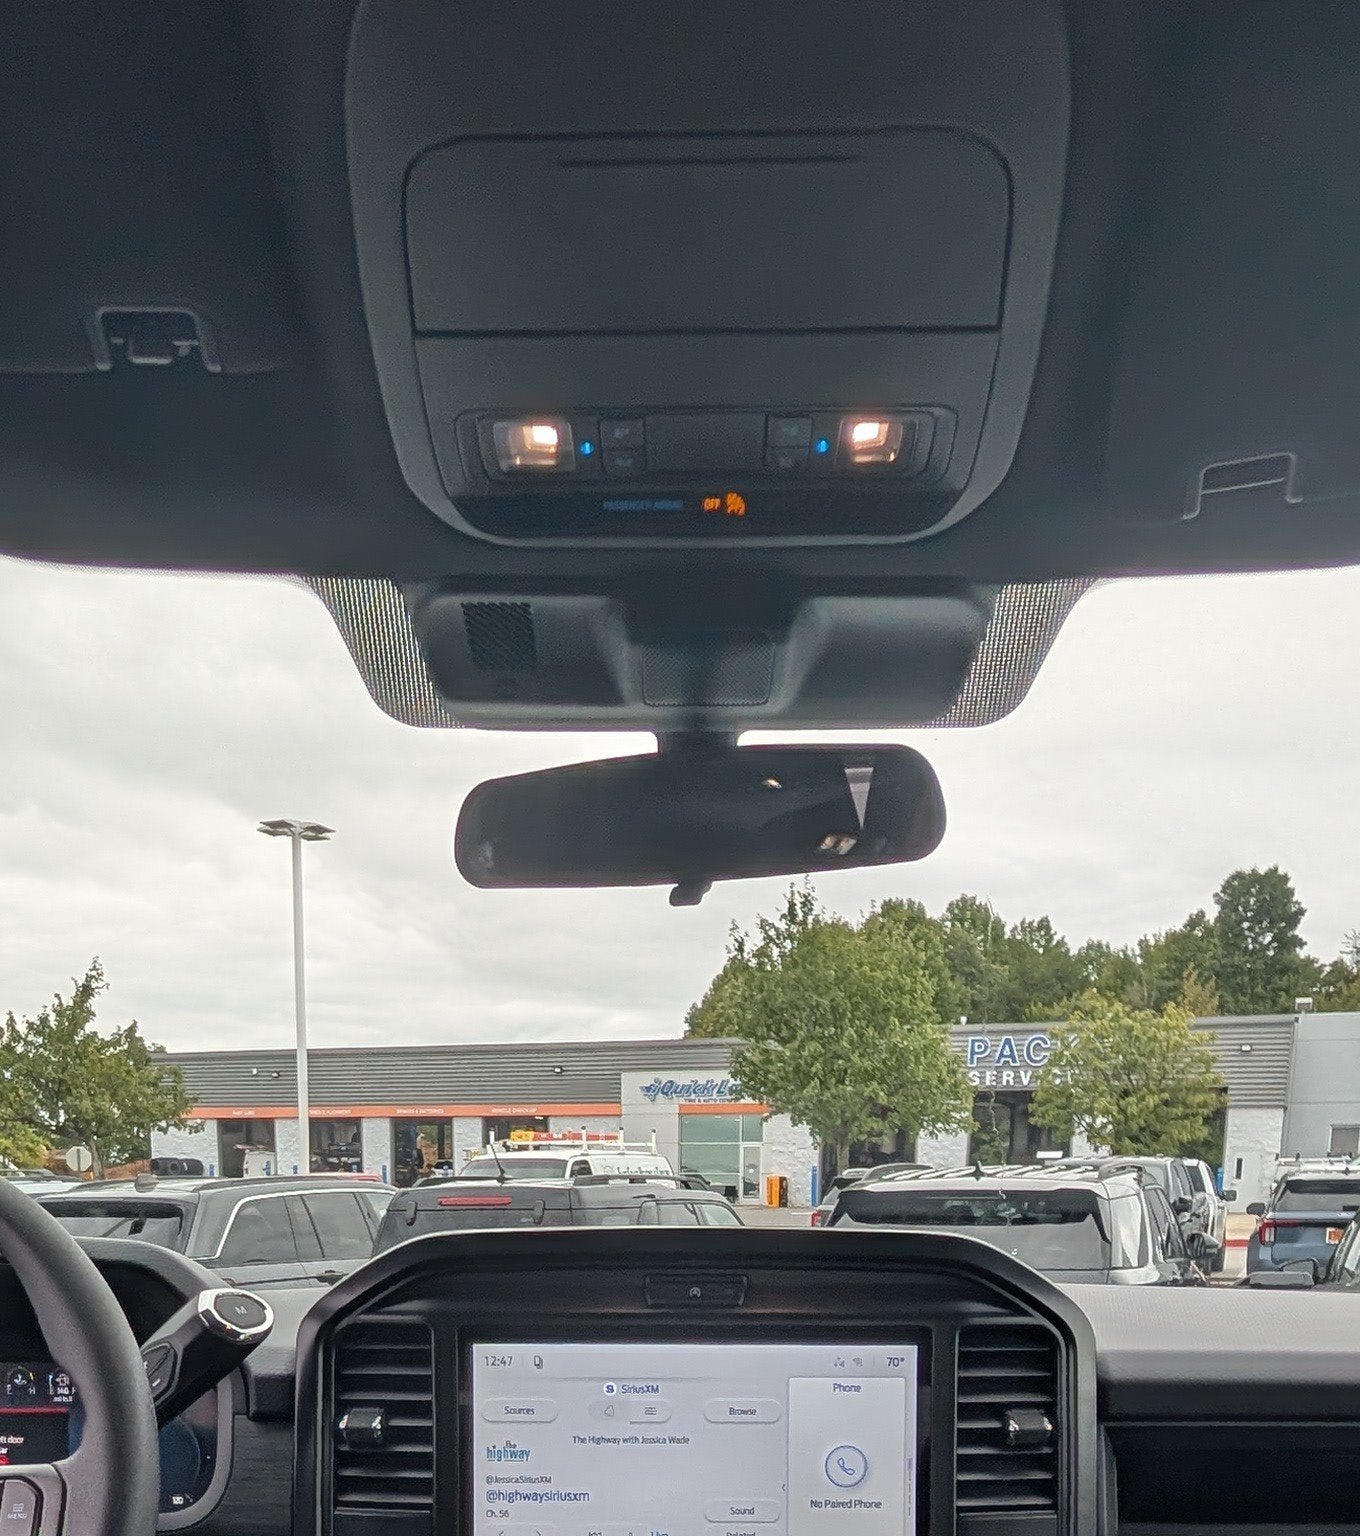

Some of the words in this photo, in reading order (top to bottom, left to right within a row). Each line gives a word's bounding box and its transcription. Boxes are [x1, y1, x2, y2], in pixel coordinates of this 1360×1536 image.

[660, 1078, 715, 1100] Quick
[484, 1355, 513, 1367] 12:47
[886, 1356, 905, 1368] 70°
[621, 1384, 660, 1395] SiriusXM
[833, 1383, 862, 1393] Phone
[504, 1405, 535, 1416] Sources
[728, 1407, 757, 1416] Browse
[7, 1435, 24, 1444] door
[572, 1435, 587, 1444] The
[588, 1435, 621, 1446] Highway
[622, 1435, 639, 1444] with
[640, 1435, 666, 1444] Jessica
[667, 1435, 690, 1445] Wade
[486, 1445, 531, 1462] highway
[486, 1475, 552, 1485] @JessicaSiriusXM
[486, 1489, 590, 1504] @highwaysiriusxm
[810, 1499, 823, 1509] No
[825, 1499, 852, 1509] Paired
[853, 1499, 882, 1509] Phone
[486, 1509, 498, 1519] Ch.
[730, 1506, 755, 1516] Sound
